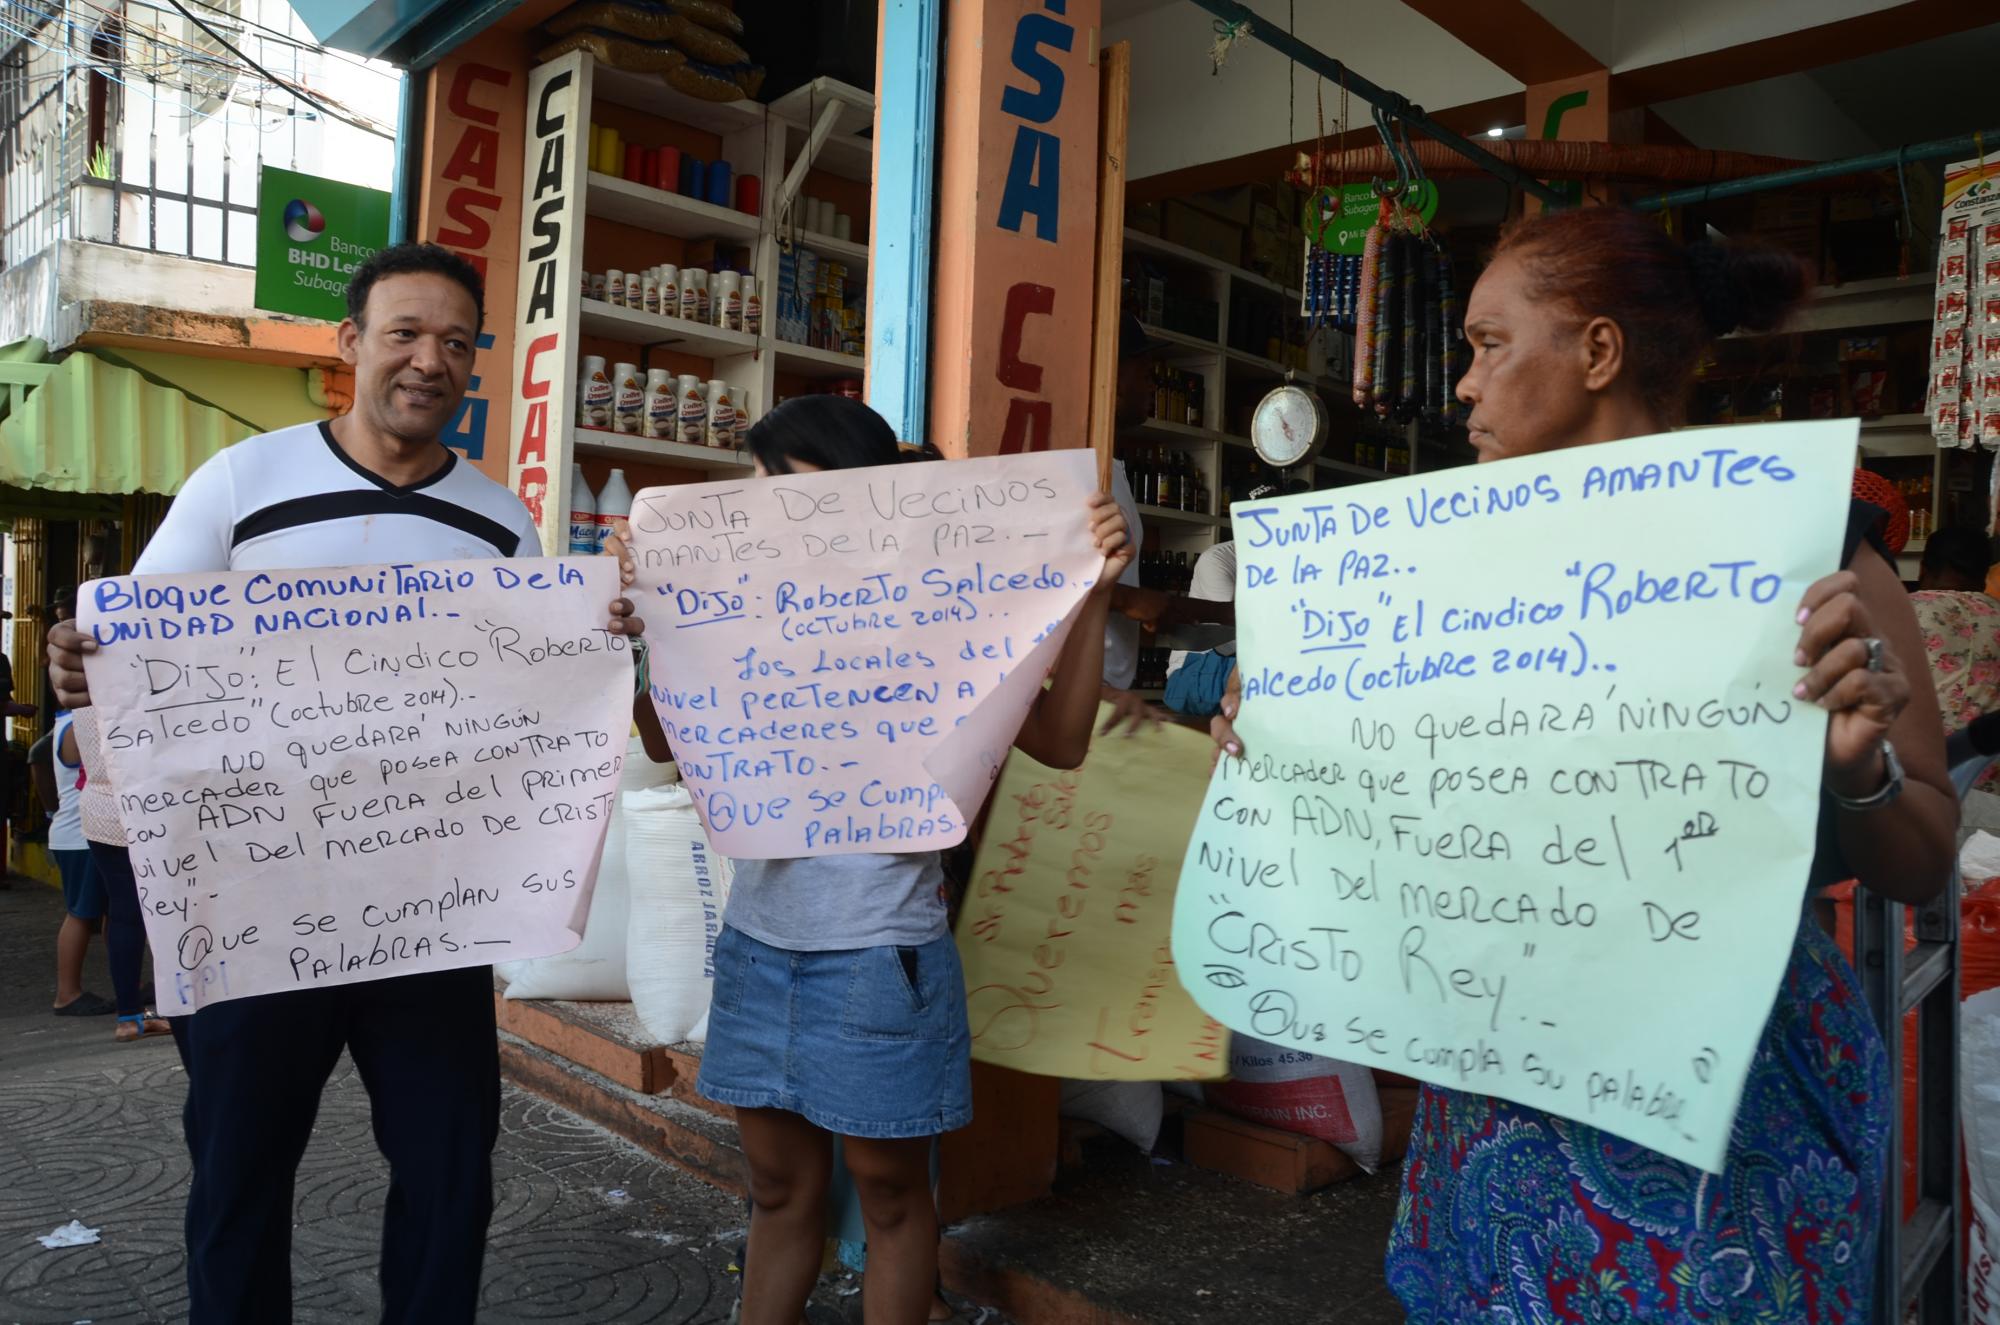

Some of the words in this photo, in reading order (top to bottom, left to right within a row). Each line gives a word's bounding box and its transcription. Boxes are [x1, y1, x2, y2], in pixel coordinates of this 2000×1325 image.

[996, 0, 1074, 243] SA
[526, 69, 572, 324] CASA
[1344, 193, 1369, 204] Banco
[288, 247, 330, 269] BHD
[330, 236, 376, 258] Banco
[276, 644, 320, 687] El
[958, 636, 1014, 660] del
[957, 680, 976, 699] A
[1240, 665, 1338, 700] Alcedo
[876, 716, 938, 743] que
[1351, 716, 1396, 751] NO
[222, 750, 265, 775] NO
[197, 803, 285, 831] ADN
[445, 774, 502, 804] del
[310, 769, 357, 801] que
[859, 778, 945, 813] Cump
[1358, 768, 1411, 803] que
[246, 831, 305, 863] Del
[482, 814, 521, 836] De
[1542, 814, 1632, 881] del
[1198, 840, 1299, 889] Nivel
[1330, 858, 1380, 902] Del
[1642, 900, 1702, 943] De
[1241, 1105, 1291, 1122] RAIN
[1295, 1104, 1332, 1121] INC.
